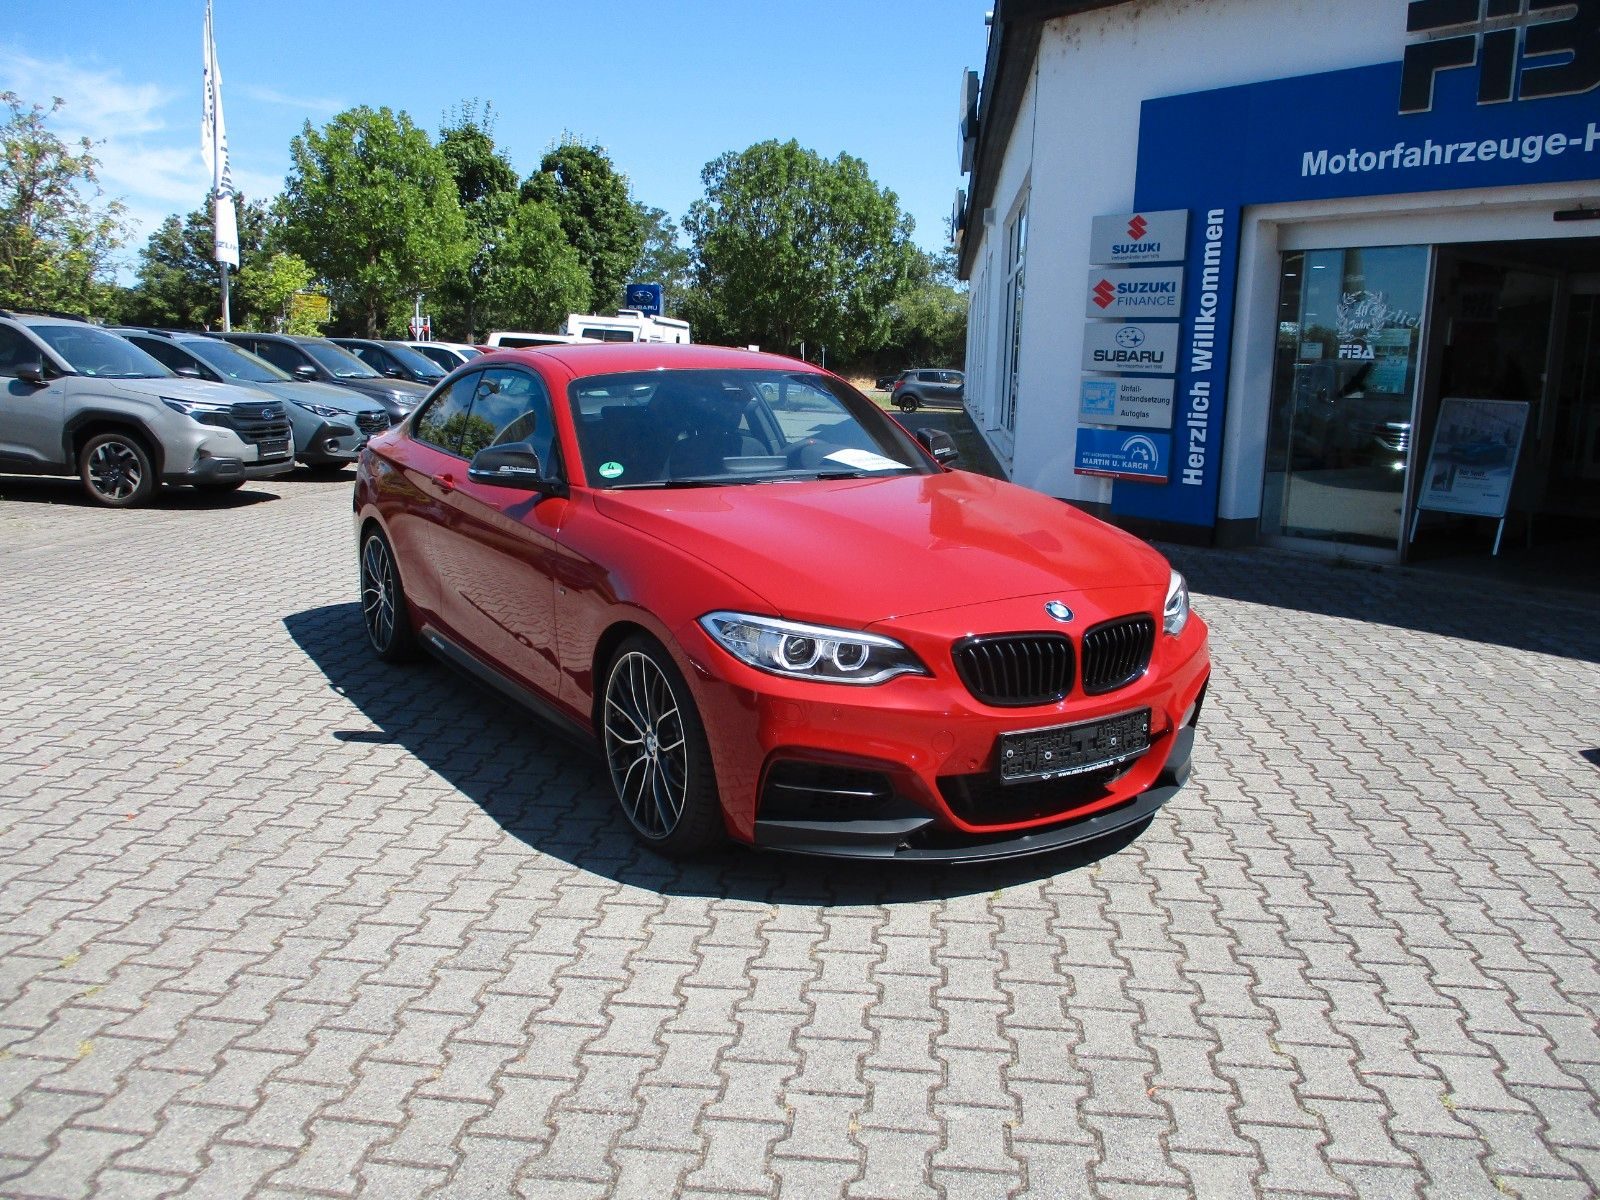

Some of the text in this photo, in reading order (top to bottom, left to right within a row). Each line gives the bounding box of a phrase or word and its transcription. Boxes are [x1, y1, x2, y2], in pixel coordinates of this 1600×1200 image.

[1112, 242, 1160, 254] SUZUKI
[1117, 281, 1176, 294] SUZUKI
[1117, 295, 1176, 306] FINANCE
[1182, 208, 1225, 486] Herzlich Willkommen
[1338, 344, 1375, 359] FIBA
[1093, 349, 1164, 363] SUBARU
[1121, 384, 1142, 392] Unfall-
[1120, 394, 1170, 405] Instandsetzung
[1120, 409, 1149, 419] Autoglas
[607, 462, 615, 470] 4
[1082, 457, 1110, 467] MARTIN
[1122, 461, 1148, 470] KARCH
